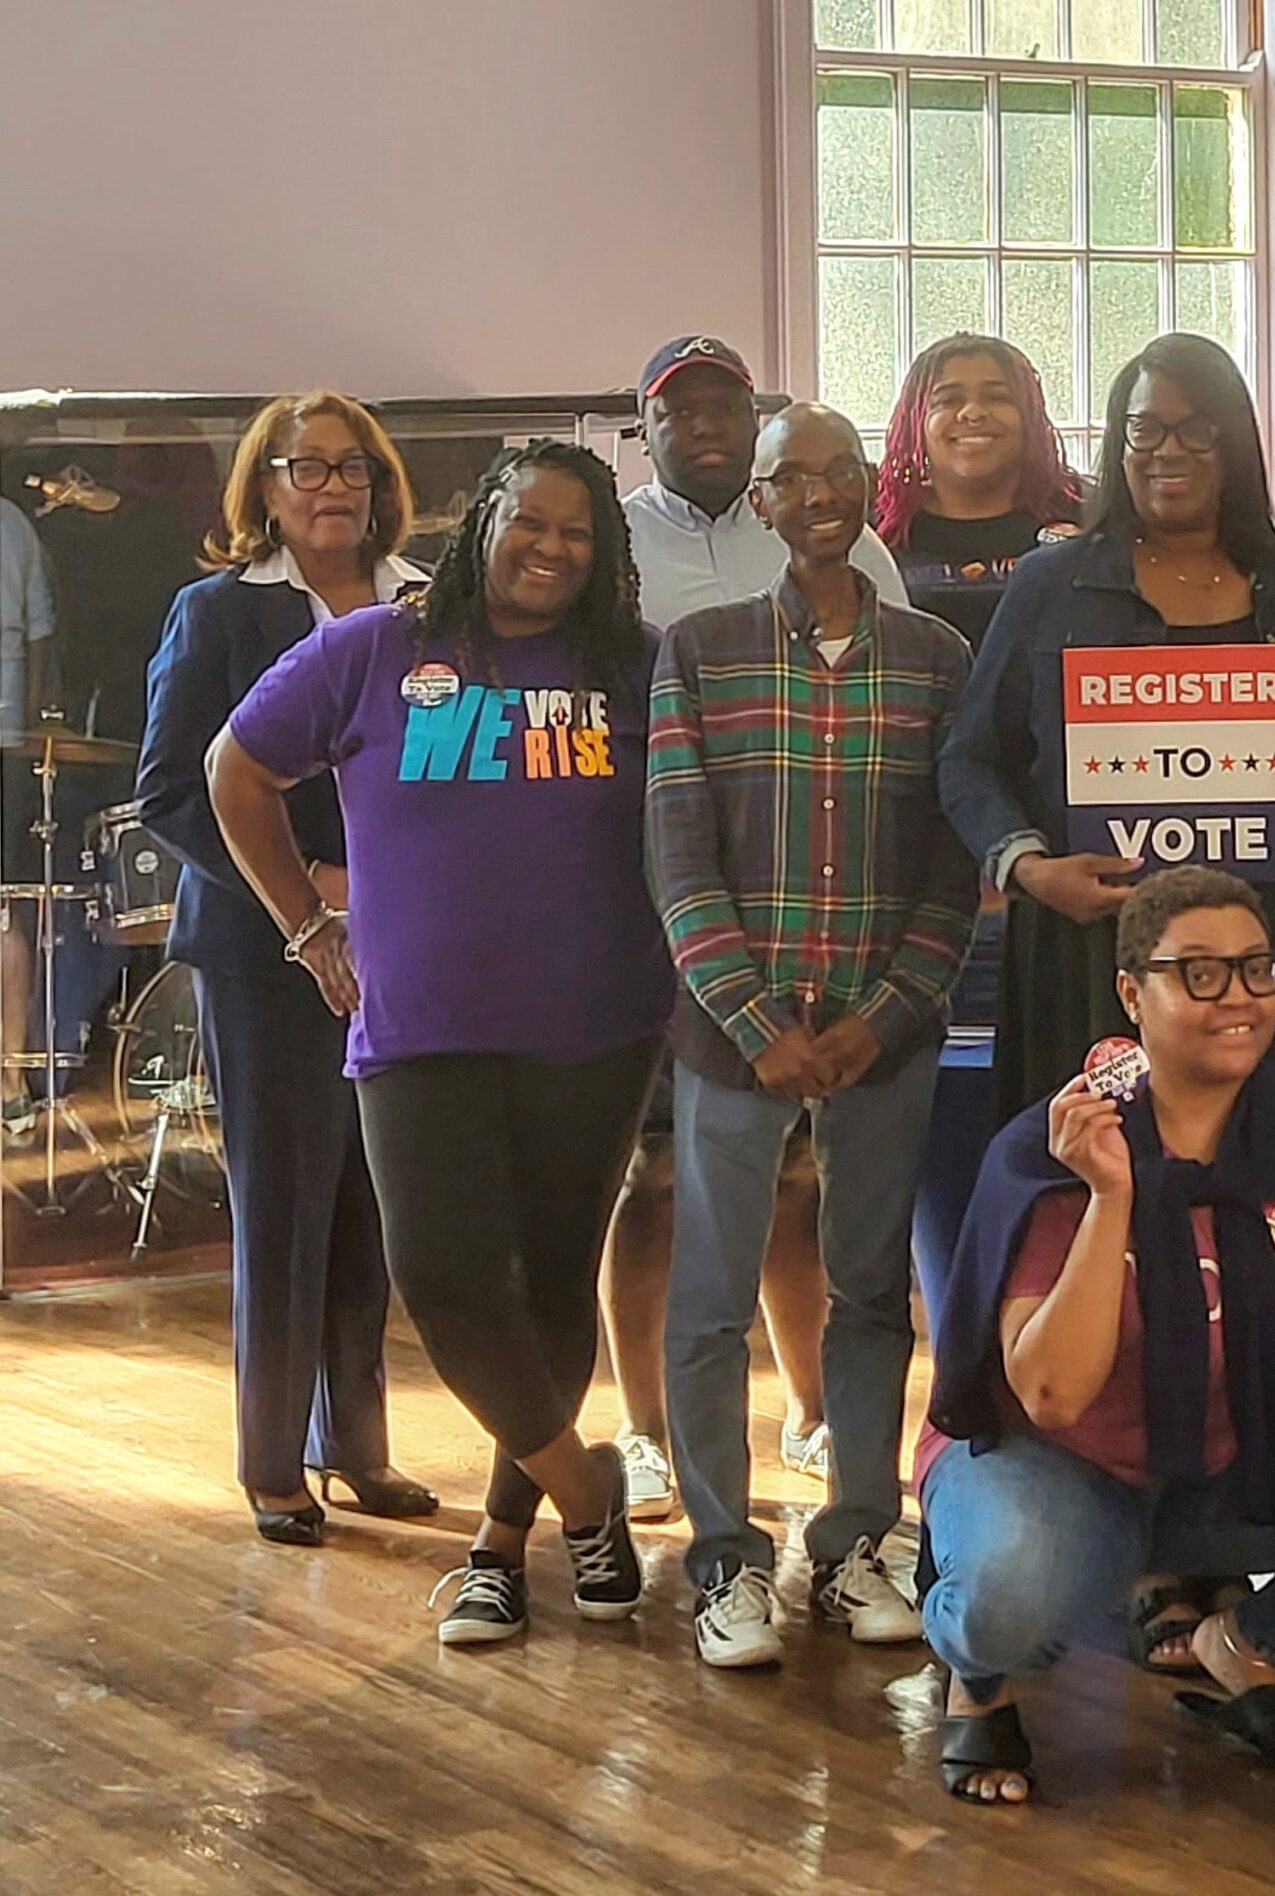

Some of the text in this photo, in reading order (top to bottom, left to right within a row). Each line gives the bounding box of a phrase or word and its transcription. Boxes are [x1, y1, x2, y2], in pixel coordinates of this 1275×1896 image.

[398, 685, 522, 781] WE
[525, 728, 614, 779] RISE
[1153, 748, 1212, 778] TO
[1107, 817, 1269, 862] VOTE
[1095, 1080, 1113, 1092] To
